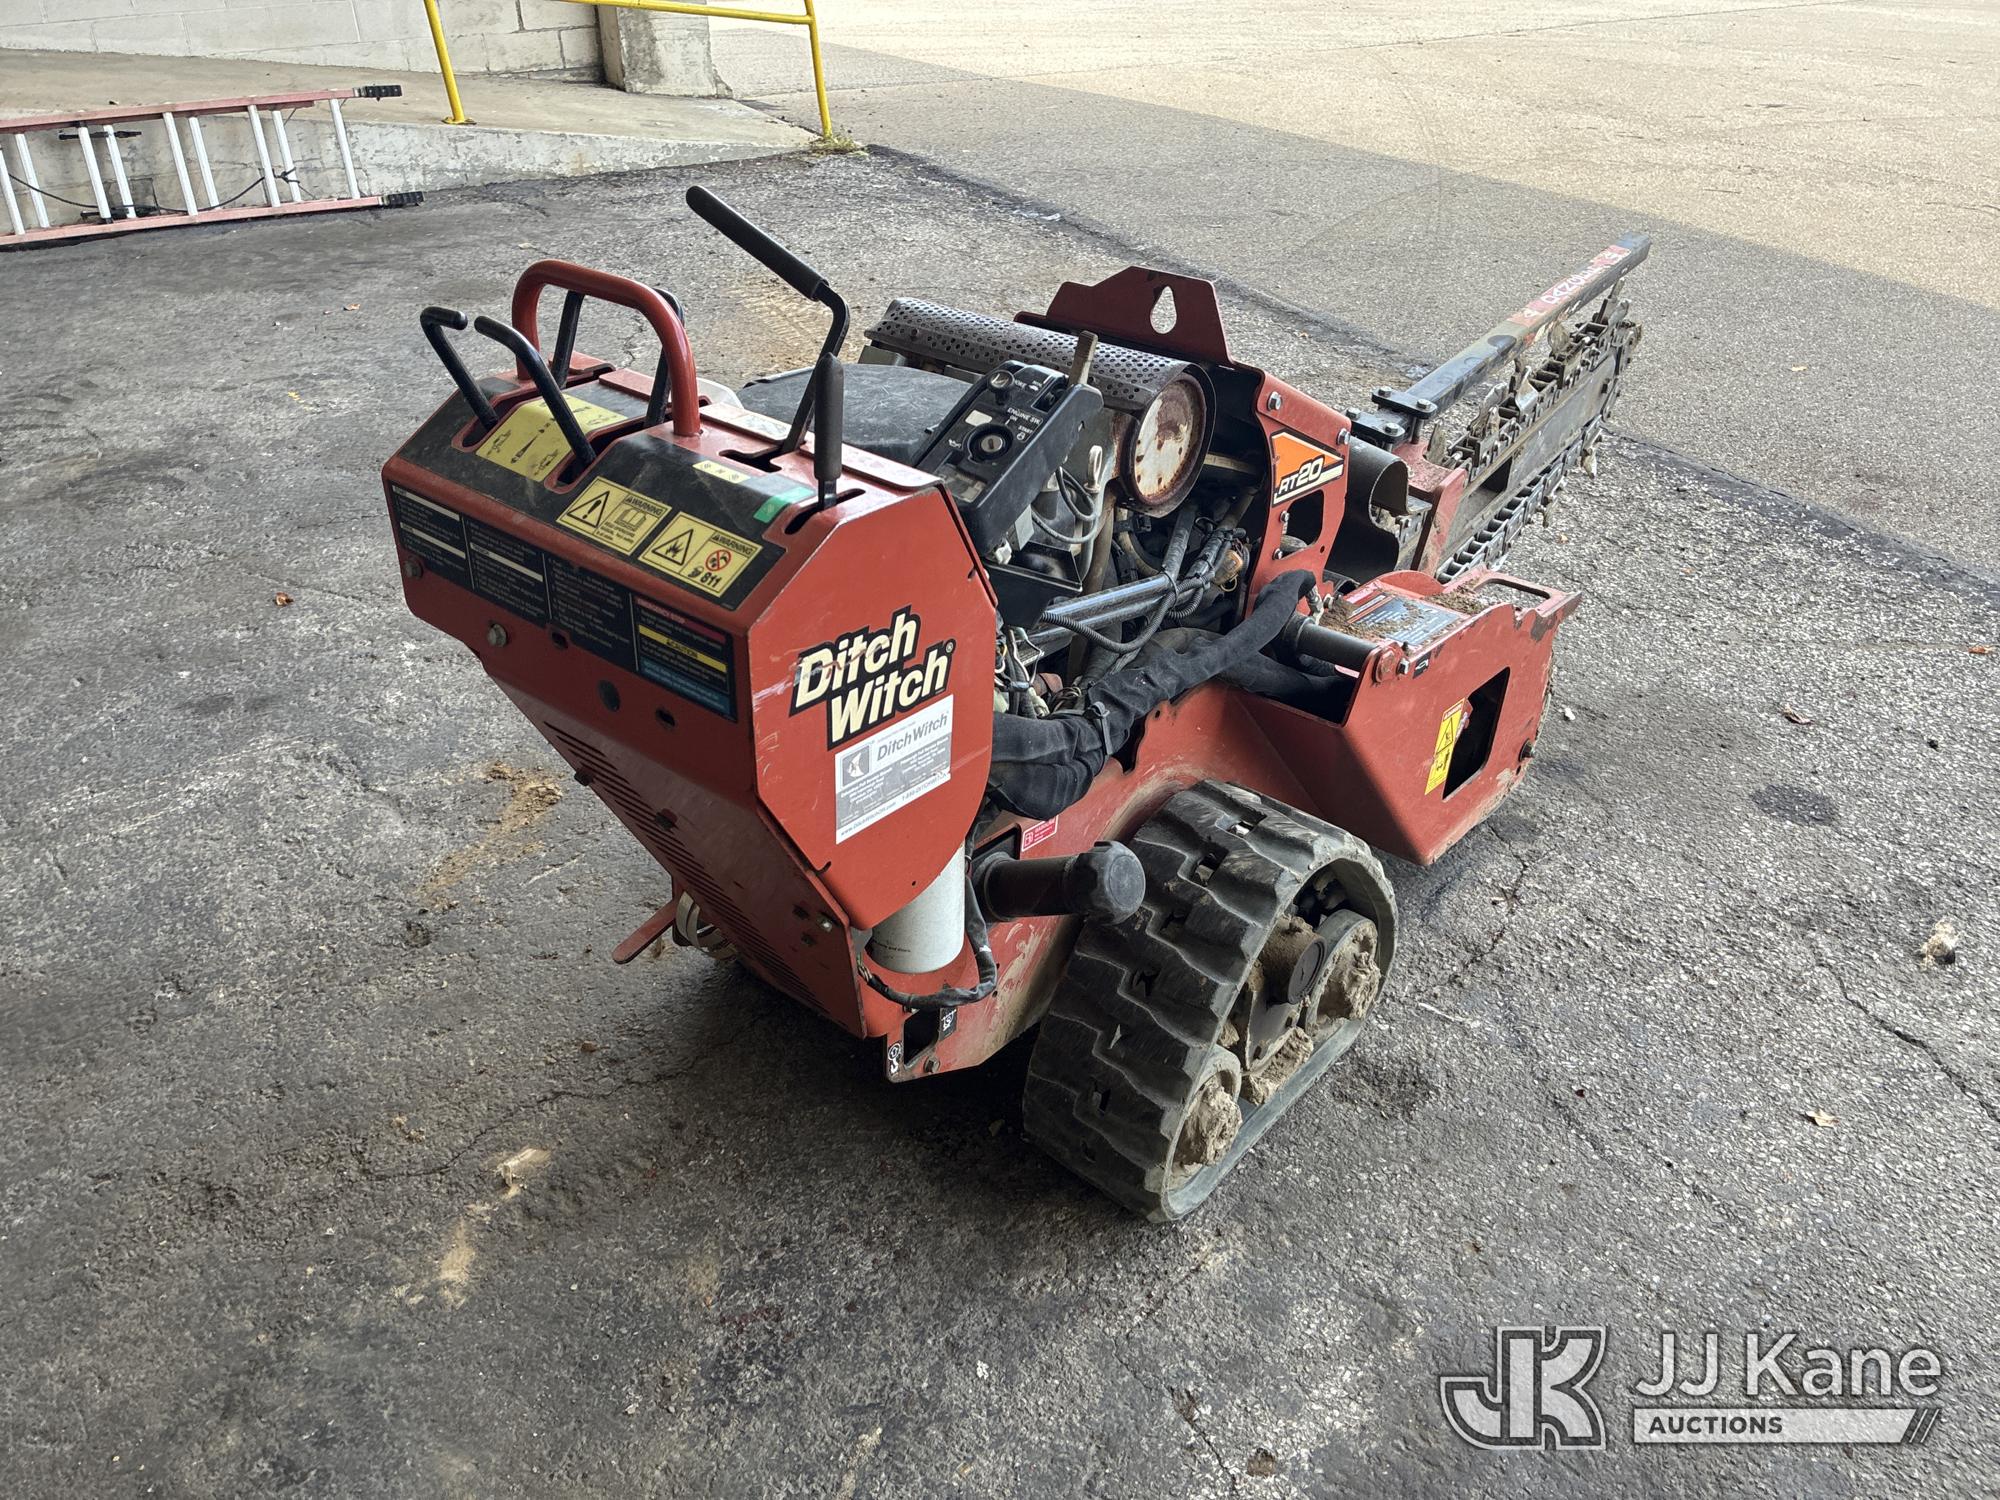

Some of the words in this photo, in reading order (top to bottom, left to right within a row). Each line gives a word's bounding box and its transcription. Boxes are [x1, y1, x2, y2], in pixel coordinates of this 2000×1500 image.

[631, 496, 663, 516] WARNING
[718, 534, 753, 555] WARNING
[700, 571, 723, 589] 811
[794, 611, 919, 710] Ditch
[830, 648, 950, 743] Witch
